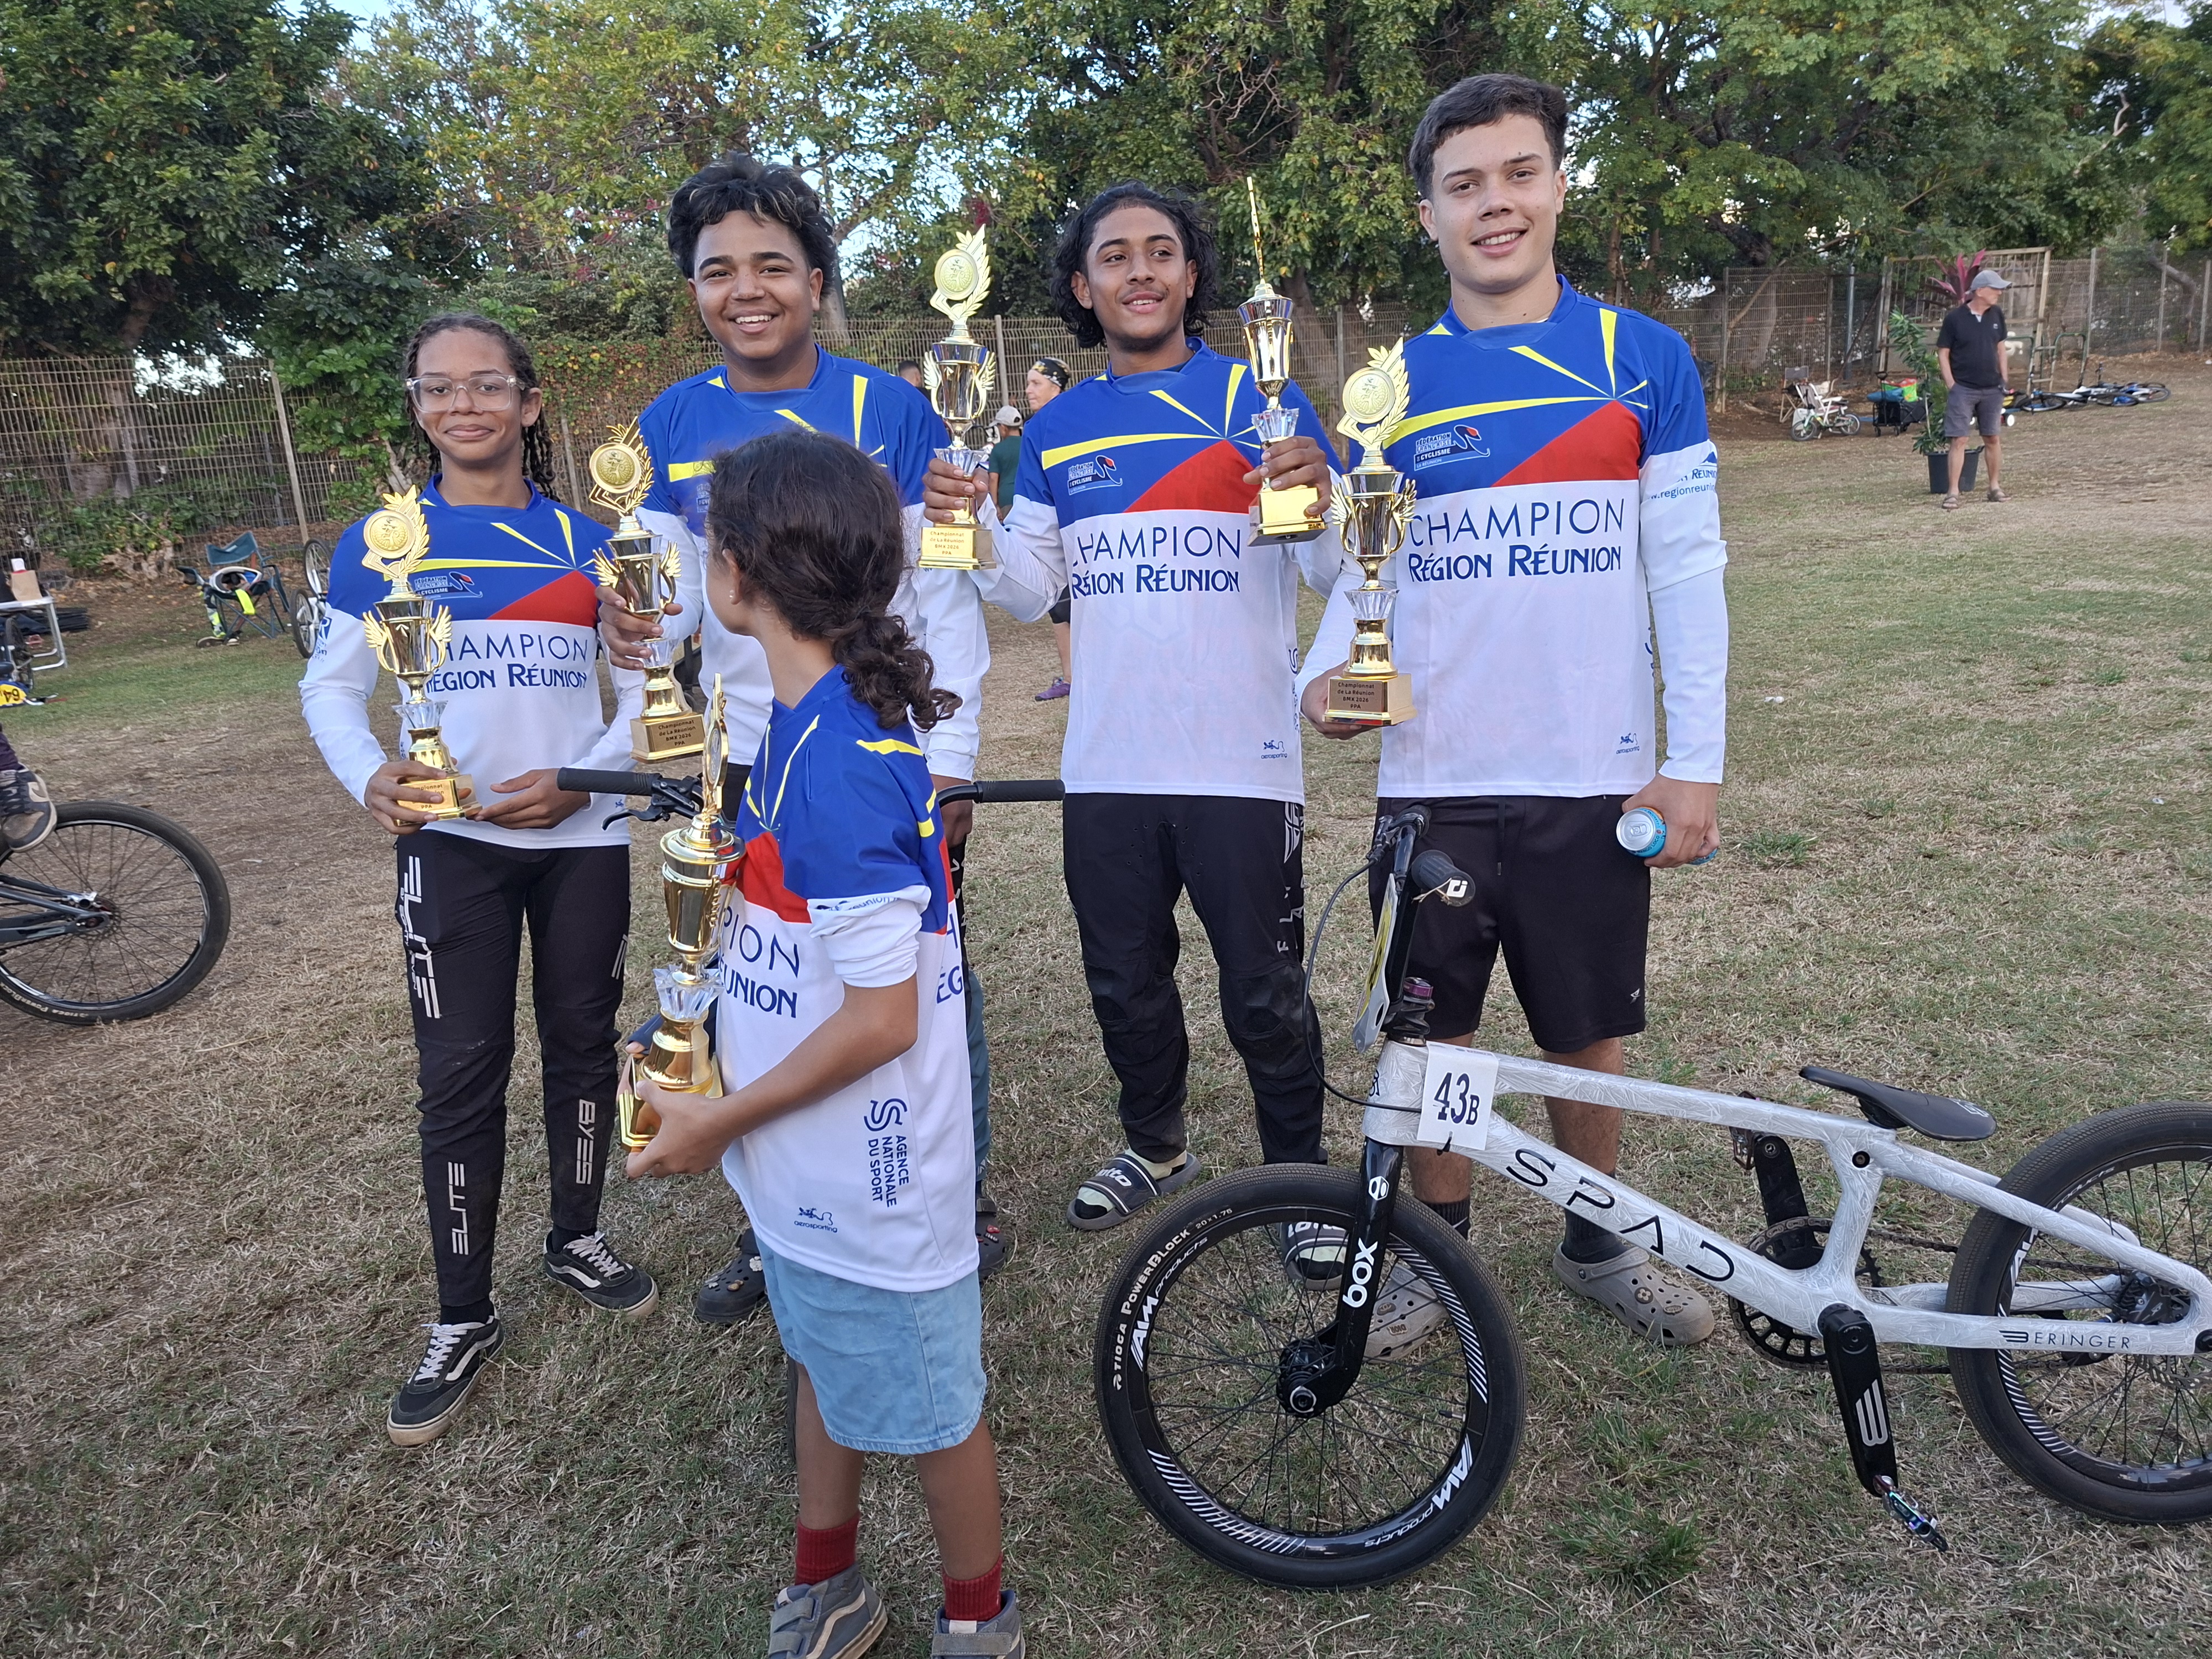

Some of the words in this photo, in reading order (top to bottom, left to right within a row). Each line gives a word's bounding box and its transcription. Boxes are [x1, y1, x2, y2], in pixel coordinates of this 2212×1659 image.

[1416, 433, 1451, 446] FÉDÉRATION
[1421, 448, 1451, 460] CYCLISME
[1072, 476, 1093, 486] CYCLISME
[1410, 498, 1624, 546] CHAMPION
[1073, 526, 1240, 565] HAMPION
[1408, 552, 1492, 582] RÉGION
[1509, 543, 1621, 576] RÉUNION
[1136, 563, 1240, 593] RÉUNION
[431, 633, 587, 663] HAMPION
[507, 663, 587, 688] RÉUNION
[658, 719, 695, 730] Championnat
[719, 953, 798, 1019] ÉUNION
[52, 1009, 79, 1017] TIOGA
[1433, 1072, 1480, 1125] 43B
[576, 1099, 596, 1185] BYES
[868, 1138, 879, 1156] DU
[896, 1135, 909, 1186] AGENCE
[870, 1159, 883, 1202] SPORT
[882, 1136, 897, 1208] NATIONALE
[1095, 1167, 1132, 1187] otto
[2052, 1166, 2115, 1211] roducts
[448, 1161, 469, 1255] ELITE
[794, 1220, 838, 1233] aerosporting
[1155, 1236, 1208, 1297] products
[1343, 1237, 1378, 1308] box
[1114, 1323, 1127, 1371] TIOGA
[1999, 1329, 2131, 1349] BERINGER
[1364, 1503, 1433, 1547] products
